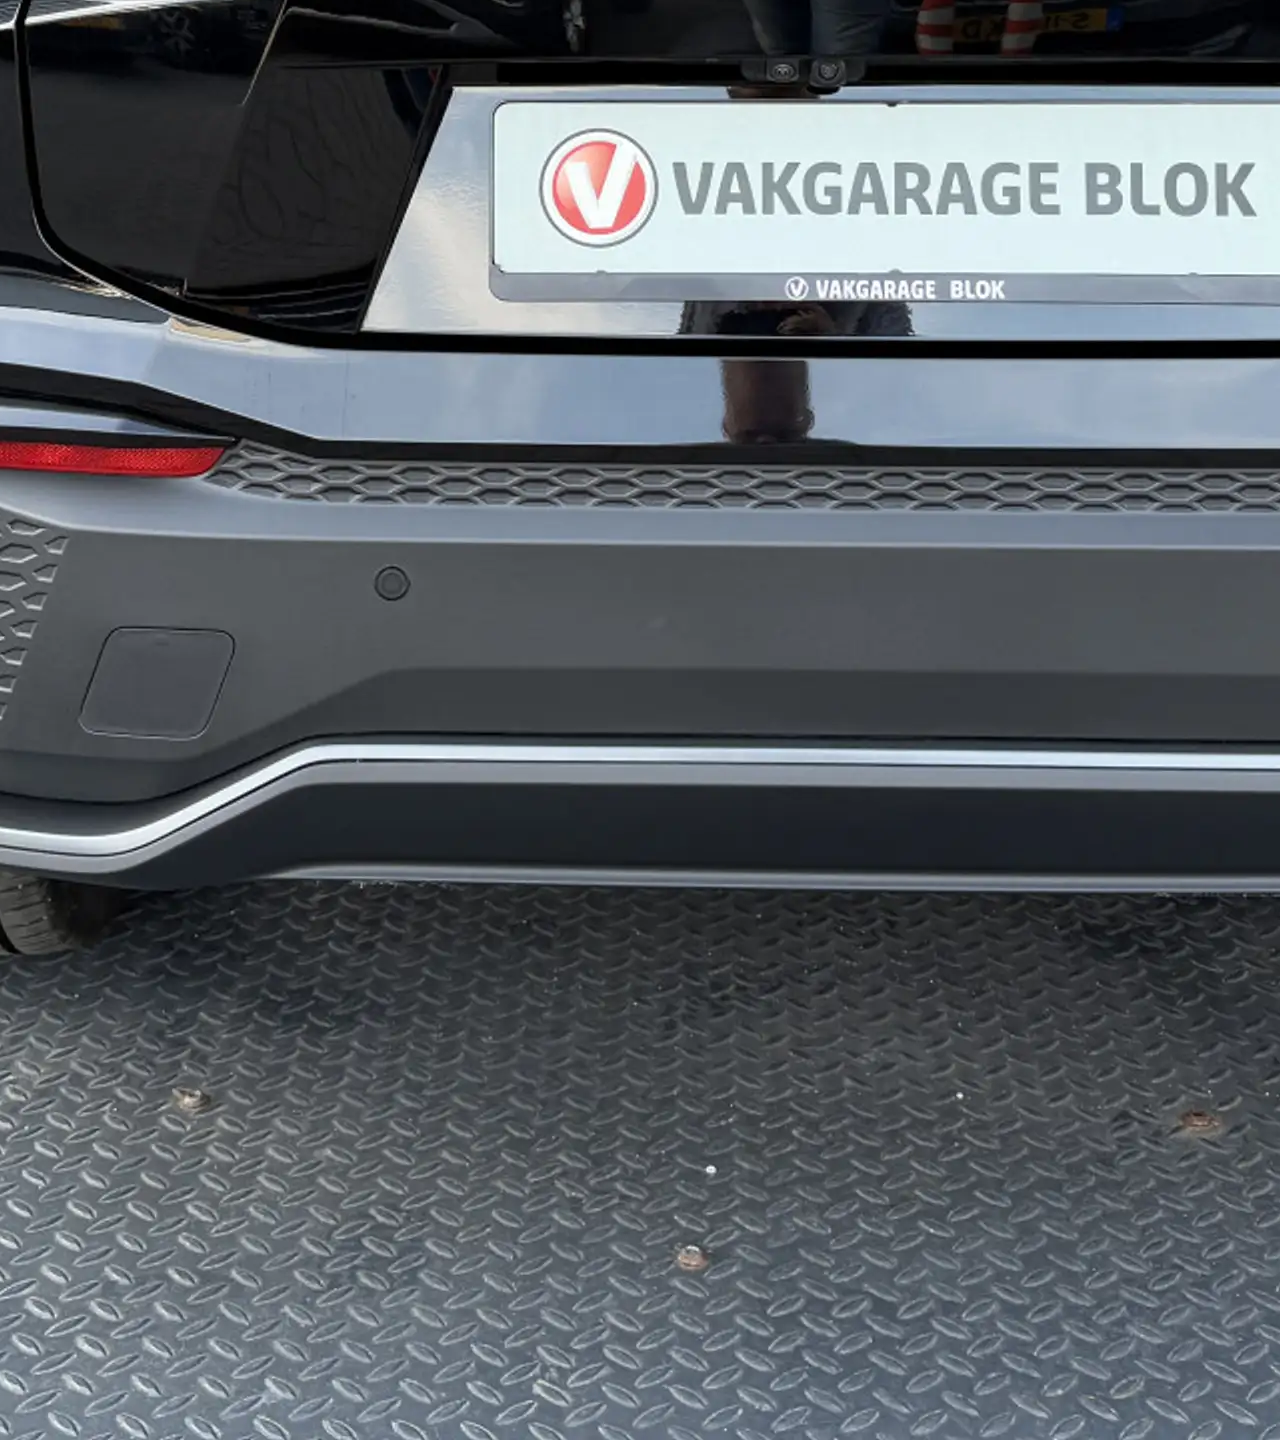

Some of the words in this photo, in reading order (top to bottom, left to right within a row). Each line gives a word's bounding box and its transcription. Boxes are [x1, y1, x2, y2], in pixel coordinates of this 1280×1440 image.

[673, 161, 1061, 216] VAKGARAGE
[1085, 162, 1257, 217] BLOK
[816, 280, 936, 299] VAKGARAGE
[950, 280, 1005, 299] BLOK
